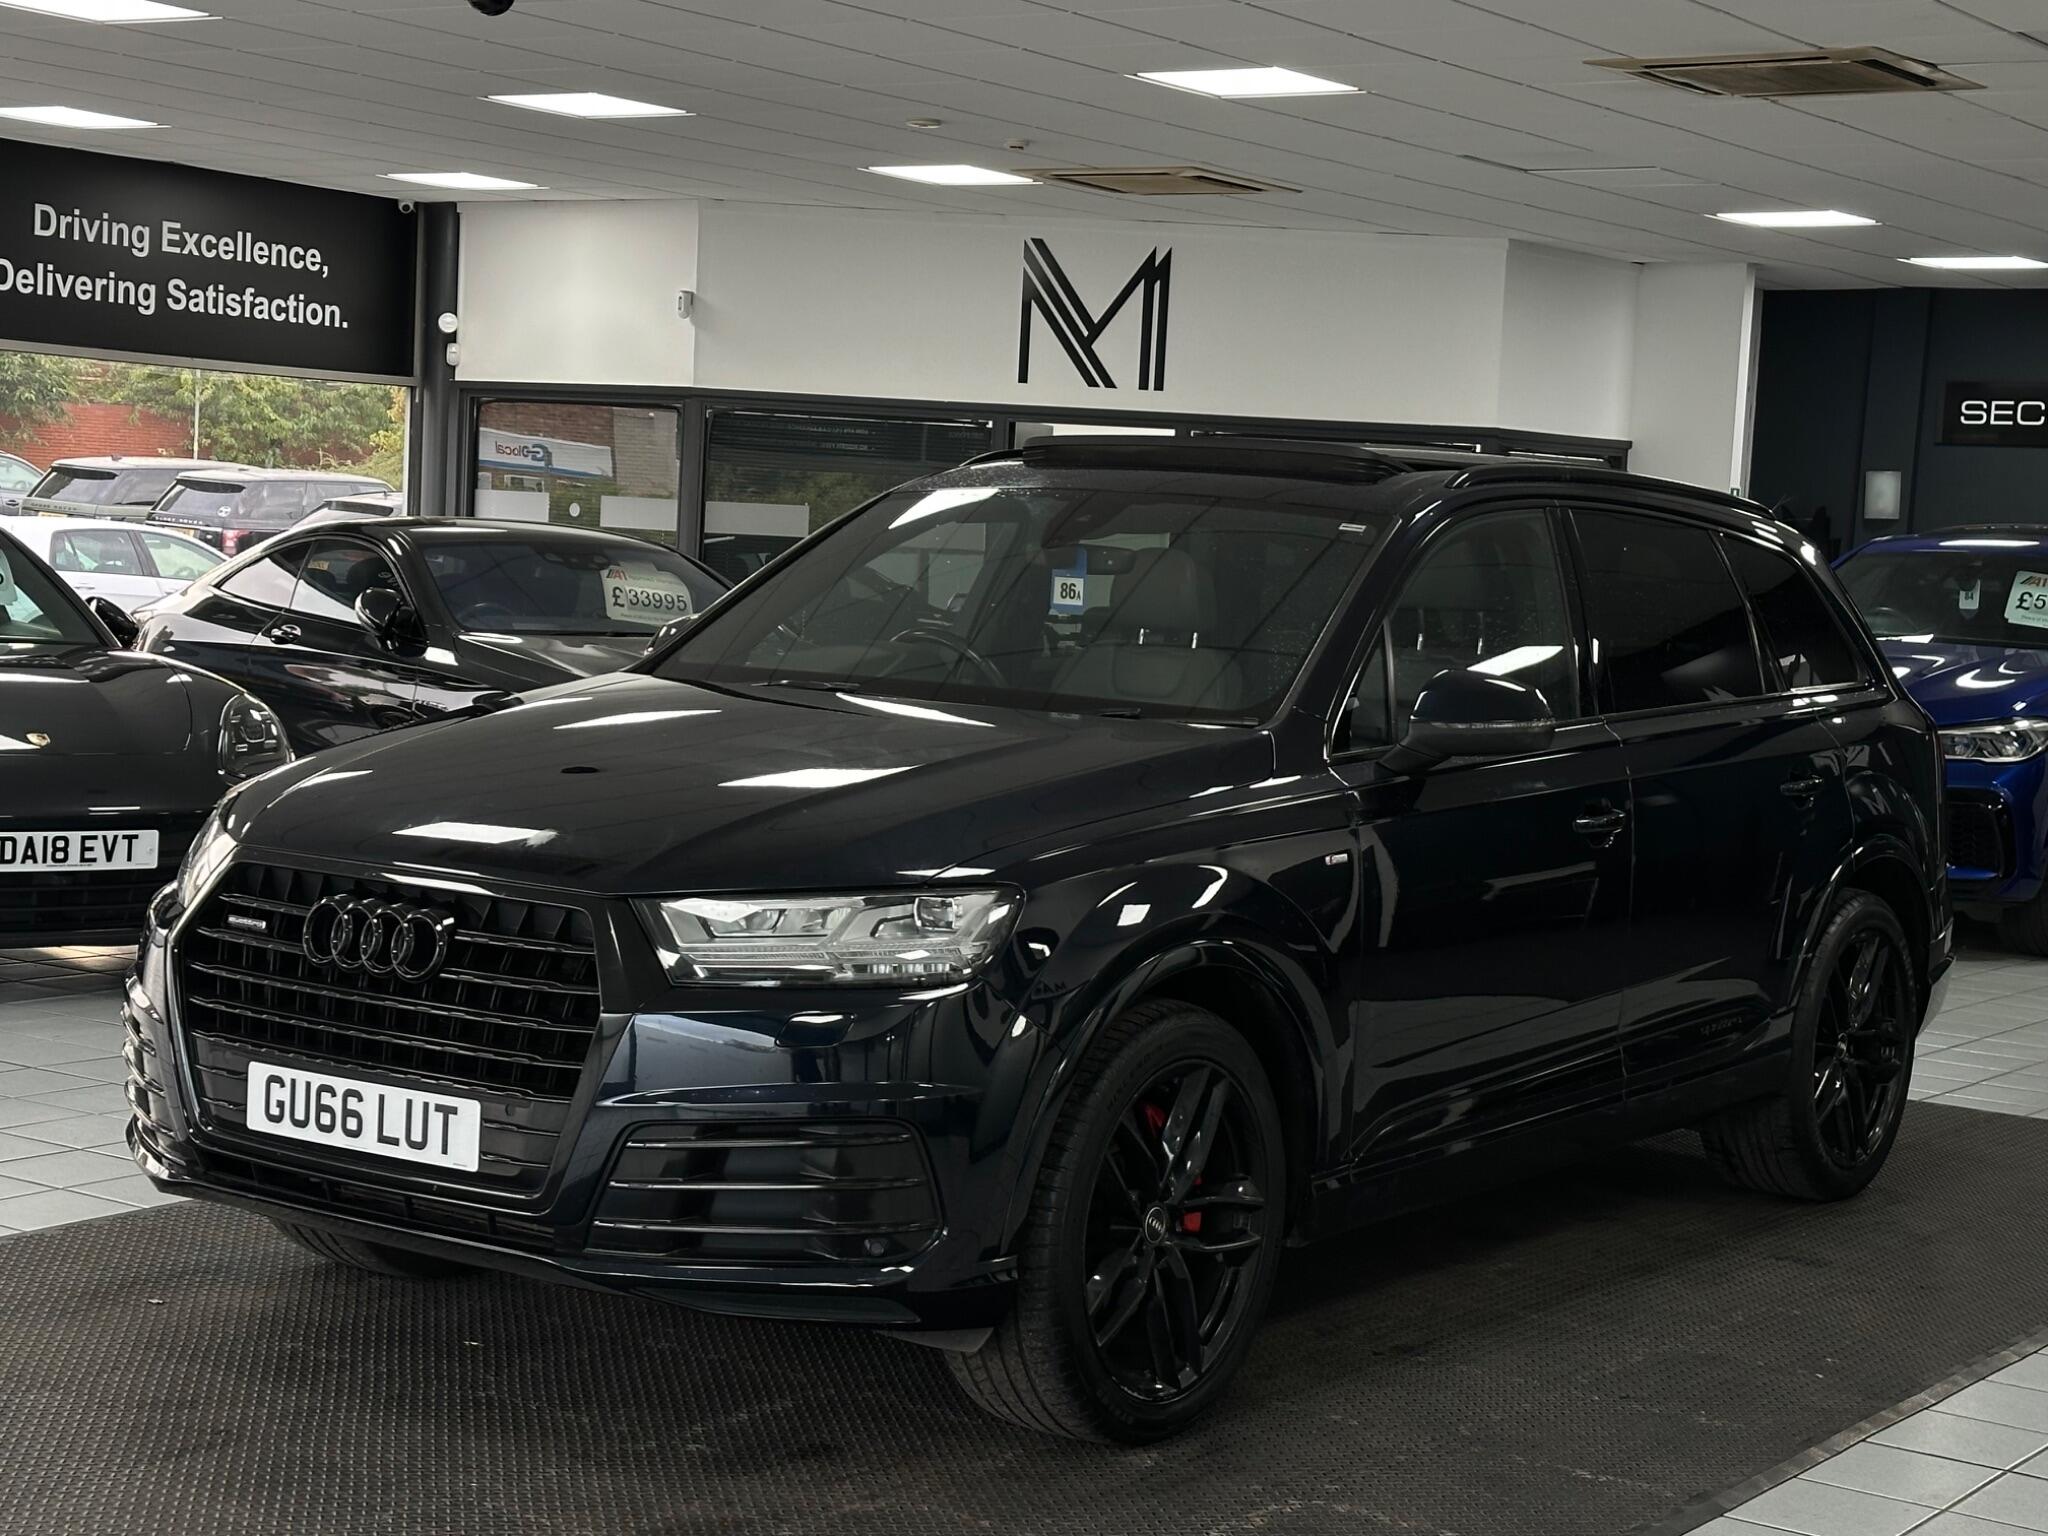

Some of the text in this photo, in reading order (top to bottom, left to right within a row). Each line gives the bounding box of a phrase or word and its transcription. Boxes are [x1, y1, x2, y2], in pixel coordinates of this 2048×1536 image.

[34, 203, 329, 278] Driving Excellence,
[0, 258, 348, 328] Delivering Satisfaction.
[1960, 400, 2045, 426] SEC
[612, 586, 688, 612] £33995
[2015, 591, 2047, 611] £5
[0, 834, 139, 864] DA18 EVT
[264, 1074, 458, 1156] GU66 LUT
